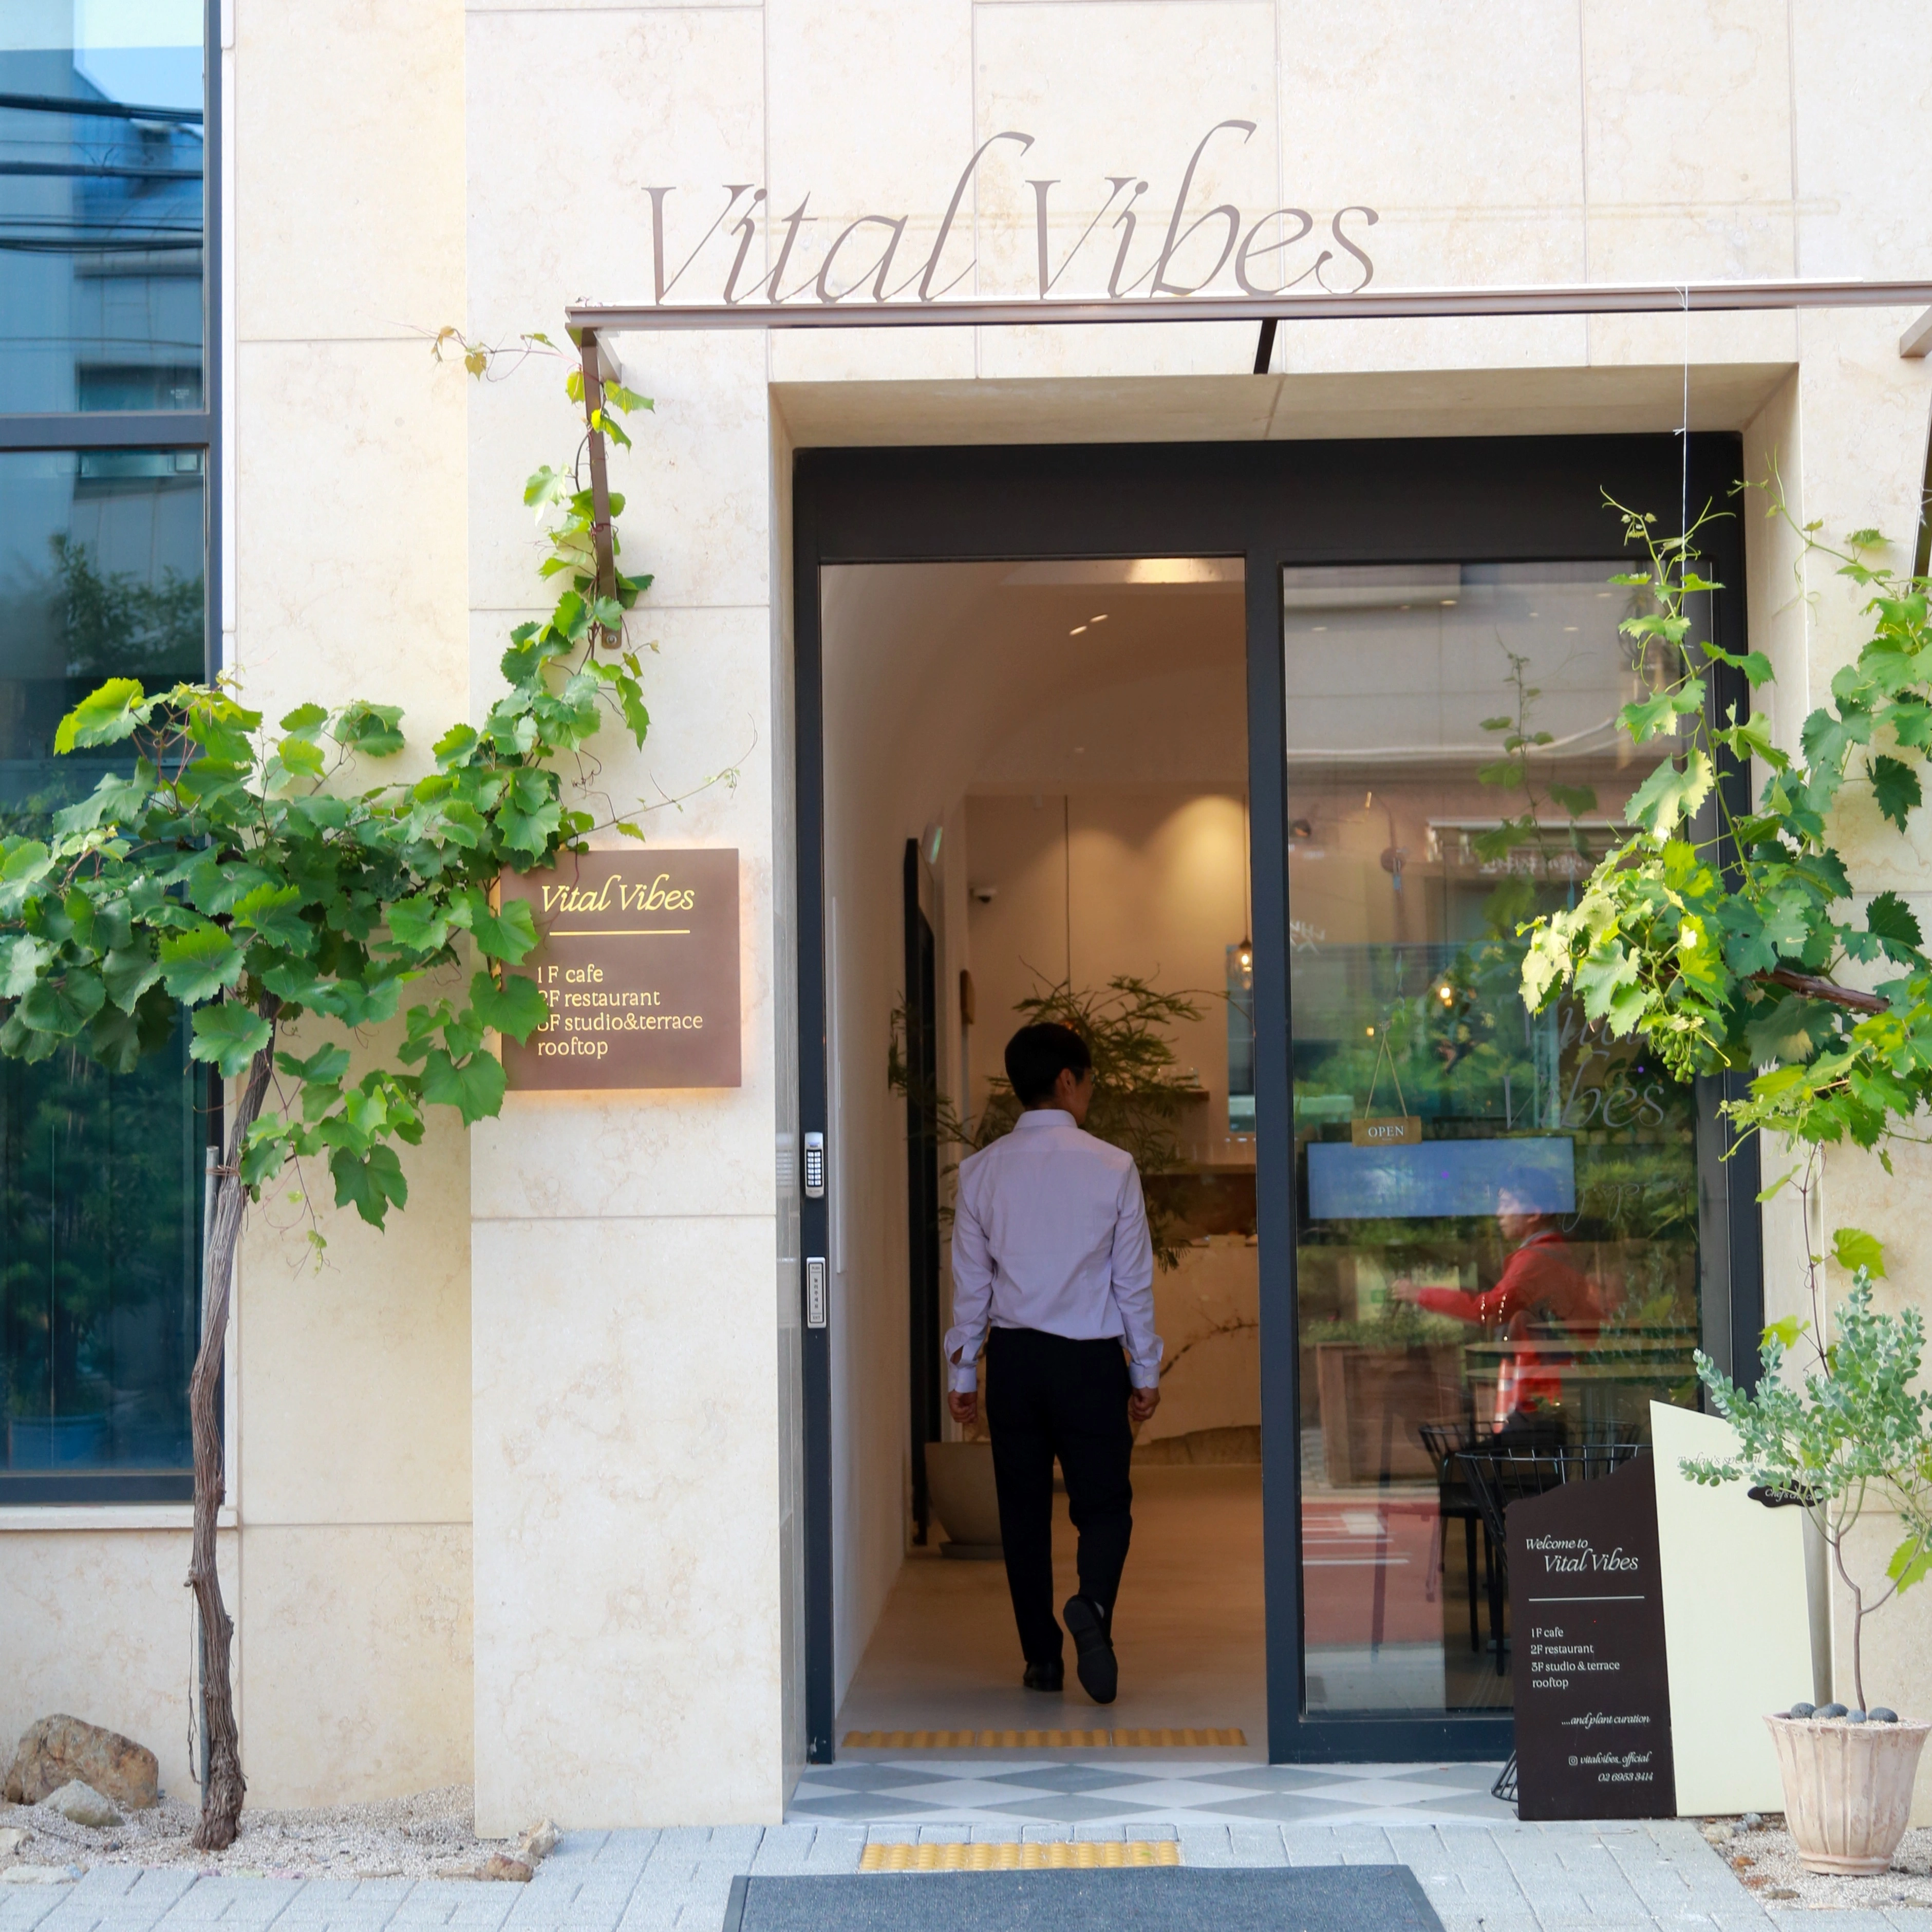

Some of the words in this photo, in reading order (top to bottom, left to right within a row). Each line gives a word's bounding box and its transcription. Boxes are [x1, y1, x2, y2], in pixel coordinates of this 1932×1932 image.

[641, 132, 1035, 306] Vital
[1025, 120, 1379, 299] Vibes
[542, 874, 622, 912] Vital
[620, 873, 695, 912] Vibes
[565, 963, 604, 983] cafe
[565, 990, 661, 1007] restaurant
[565, 1012, 703, 1031] studio&terrace
[538, 1036, 608, 1059] rooftop
[1503, 1049, 1664, 1129] Vibes
[1368, 1126, 1403, 1137] OPEN
[1526, 1534, 1575, 1550] Welcome
[1577, 1539, 1588, 1549] to
[1545, 1548, 1593, 1572] Vital
[1592, 1547, 1639, 1571] Vibes
[1544, 1626, 1564, 1638] cafe
[1530, 1645, 1543, 1655] 2F
[1545, 1644, 1594, 1654] restaurant
[1531, 1662, 1544, 1672] 3F
[1545, 1661, 1576, 1671] studio
[1577, 1662, 1585, 1671] &
[1587, 1661, 1620, 1670] terrace
[1532, 1677, 1569, 1689] rooftop
[1585, 1712, 1612, 1730] plant
[1614, 1714, 1650, 1723] curation
[1580, 1751, 1653, 1768] vitalvibes_official
[1598, 1773, 1610, 1781] 02
